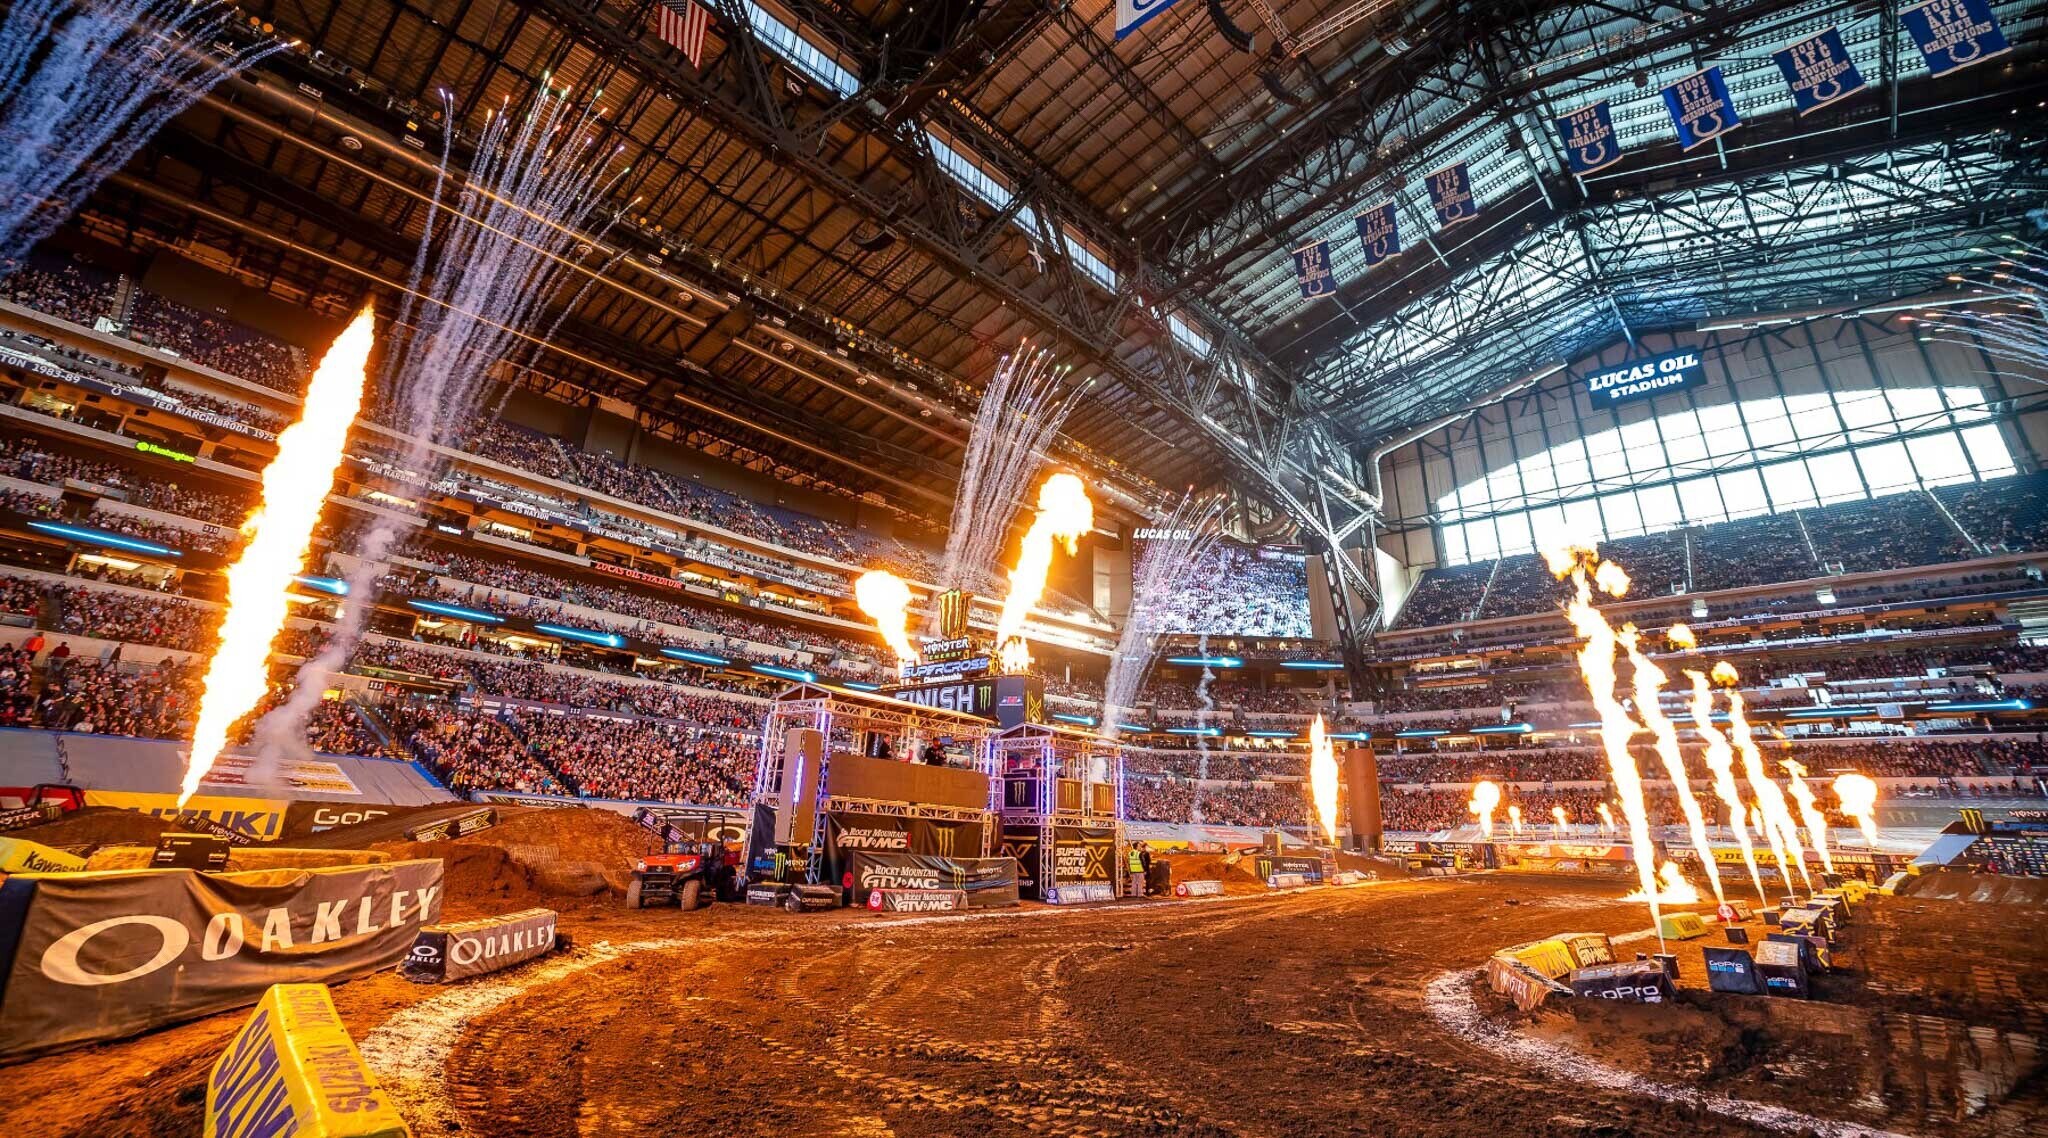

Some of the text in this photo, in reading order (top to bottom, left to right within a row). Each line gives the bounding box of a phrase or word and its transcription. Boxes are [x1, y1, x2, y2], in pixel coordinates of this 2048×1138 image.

[1927, 2, 1968, 30] AFC
[1923, 20, 1993, 54] CHAMPIONS
[1932, 16, 1974, 39] SOUTH
[1790, 37, 1823, 57] 2004
[1794, 43, 1831, 71] AFC
[1791, 59, 1850, 92] CHAMPIONS
[1798, 57, 1835, 79] SOUTH
[1681, 84, 1710, 105] AFC
[1684, 94, 1713, 113] SOUTH
[1680, 98, 1725, 125] CHAMPIONS
[1567, 124, 1610, 149] FINALIST
[1573, 118, 1601, 139] AFC
[1363, 224, 1394, 246] FINALIST
[31, 363, 81, 385] 1983-89
[1589, 354, 1698, 391] LUCAS OIL
[1609, 373, 1683, 399] STADIUM
[151, 398, 173, 412] TED
[149, 443, 196, 464] Huntington
[367, 462, 383, 474] JIM
[1133, 527, 1191, 540] LUCAS OIL
[595, 561, 683, 590] LUCAS OIL STADIUM
[922, 637, 968, 655] MONSTER
[928, 651, 962, 661] ENERGY
[902, 657, 990, 678] SUPERCROSS
[850, 827, 908, 838] ROCKY MOUNTAIN
[1056, 847, 1087, 857] SUPER
[1057, 857, 1085, 866] MOTO
[875, 864, 939, 878] ROCKY MOUNTAIN
[1055, 866, 1086, 876] CROSS
[201, 885, 437, 962] OAKLEY
[485, 923, 556, 959] OAKLEY
[404, 954, 442, 964] OAKLEY
[1708, 959, 1744, 969] GoPro
[307, 1043, 380, 1114] SUZUKI
